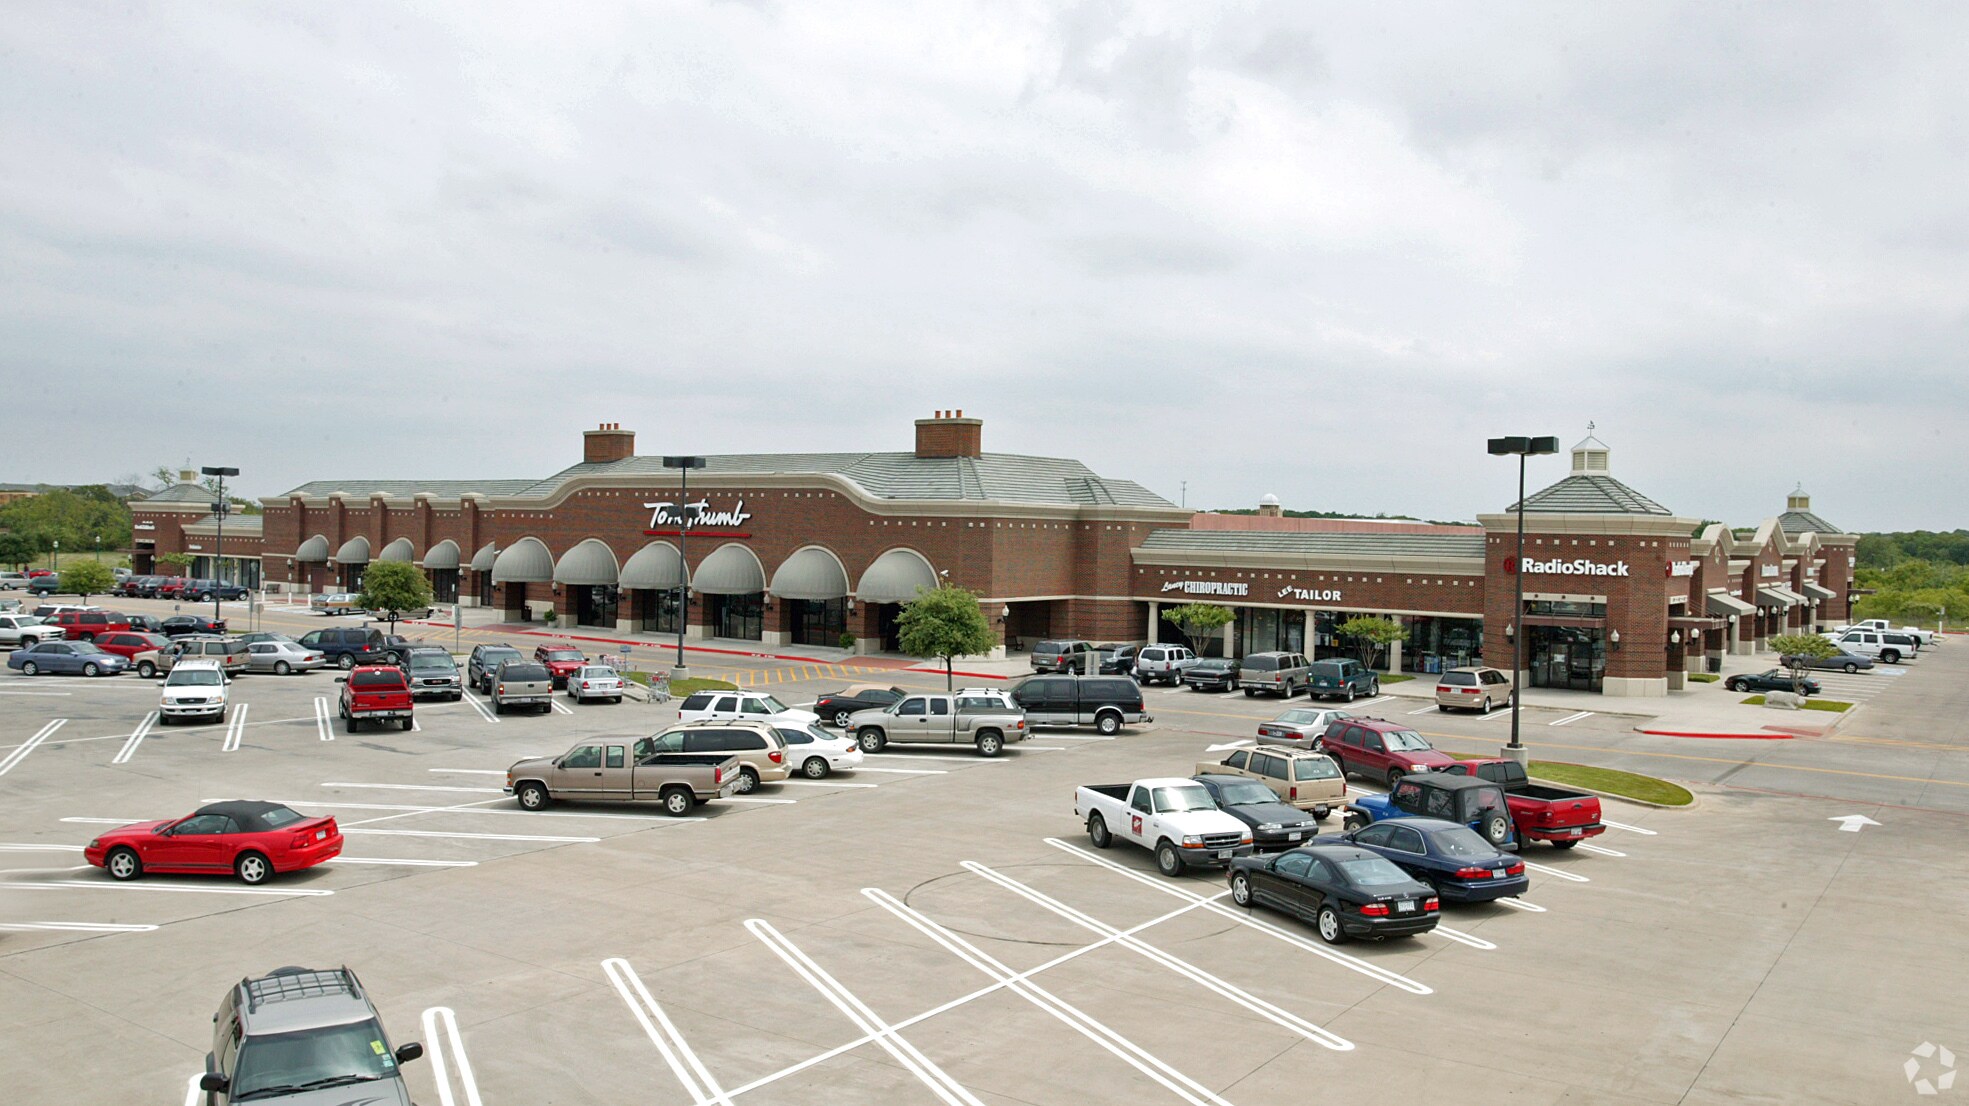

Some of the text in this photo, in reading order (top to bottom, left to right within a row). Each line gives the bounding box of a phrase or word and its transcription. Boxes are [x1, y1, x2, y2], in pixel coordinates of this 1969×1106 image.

[1521, 557, 1629, 577] RadioShack
[1184, 580, 1249, 596] CHIROPRACTIC
[1293, 588, 1342, 601] TAILOR
